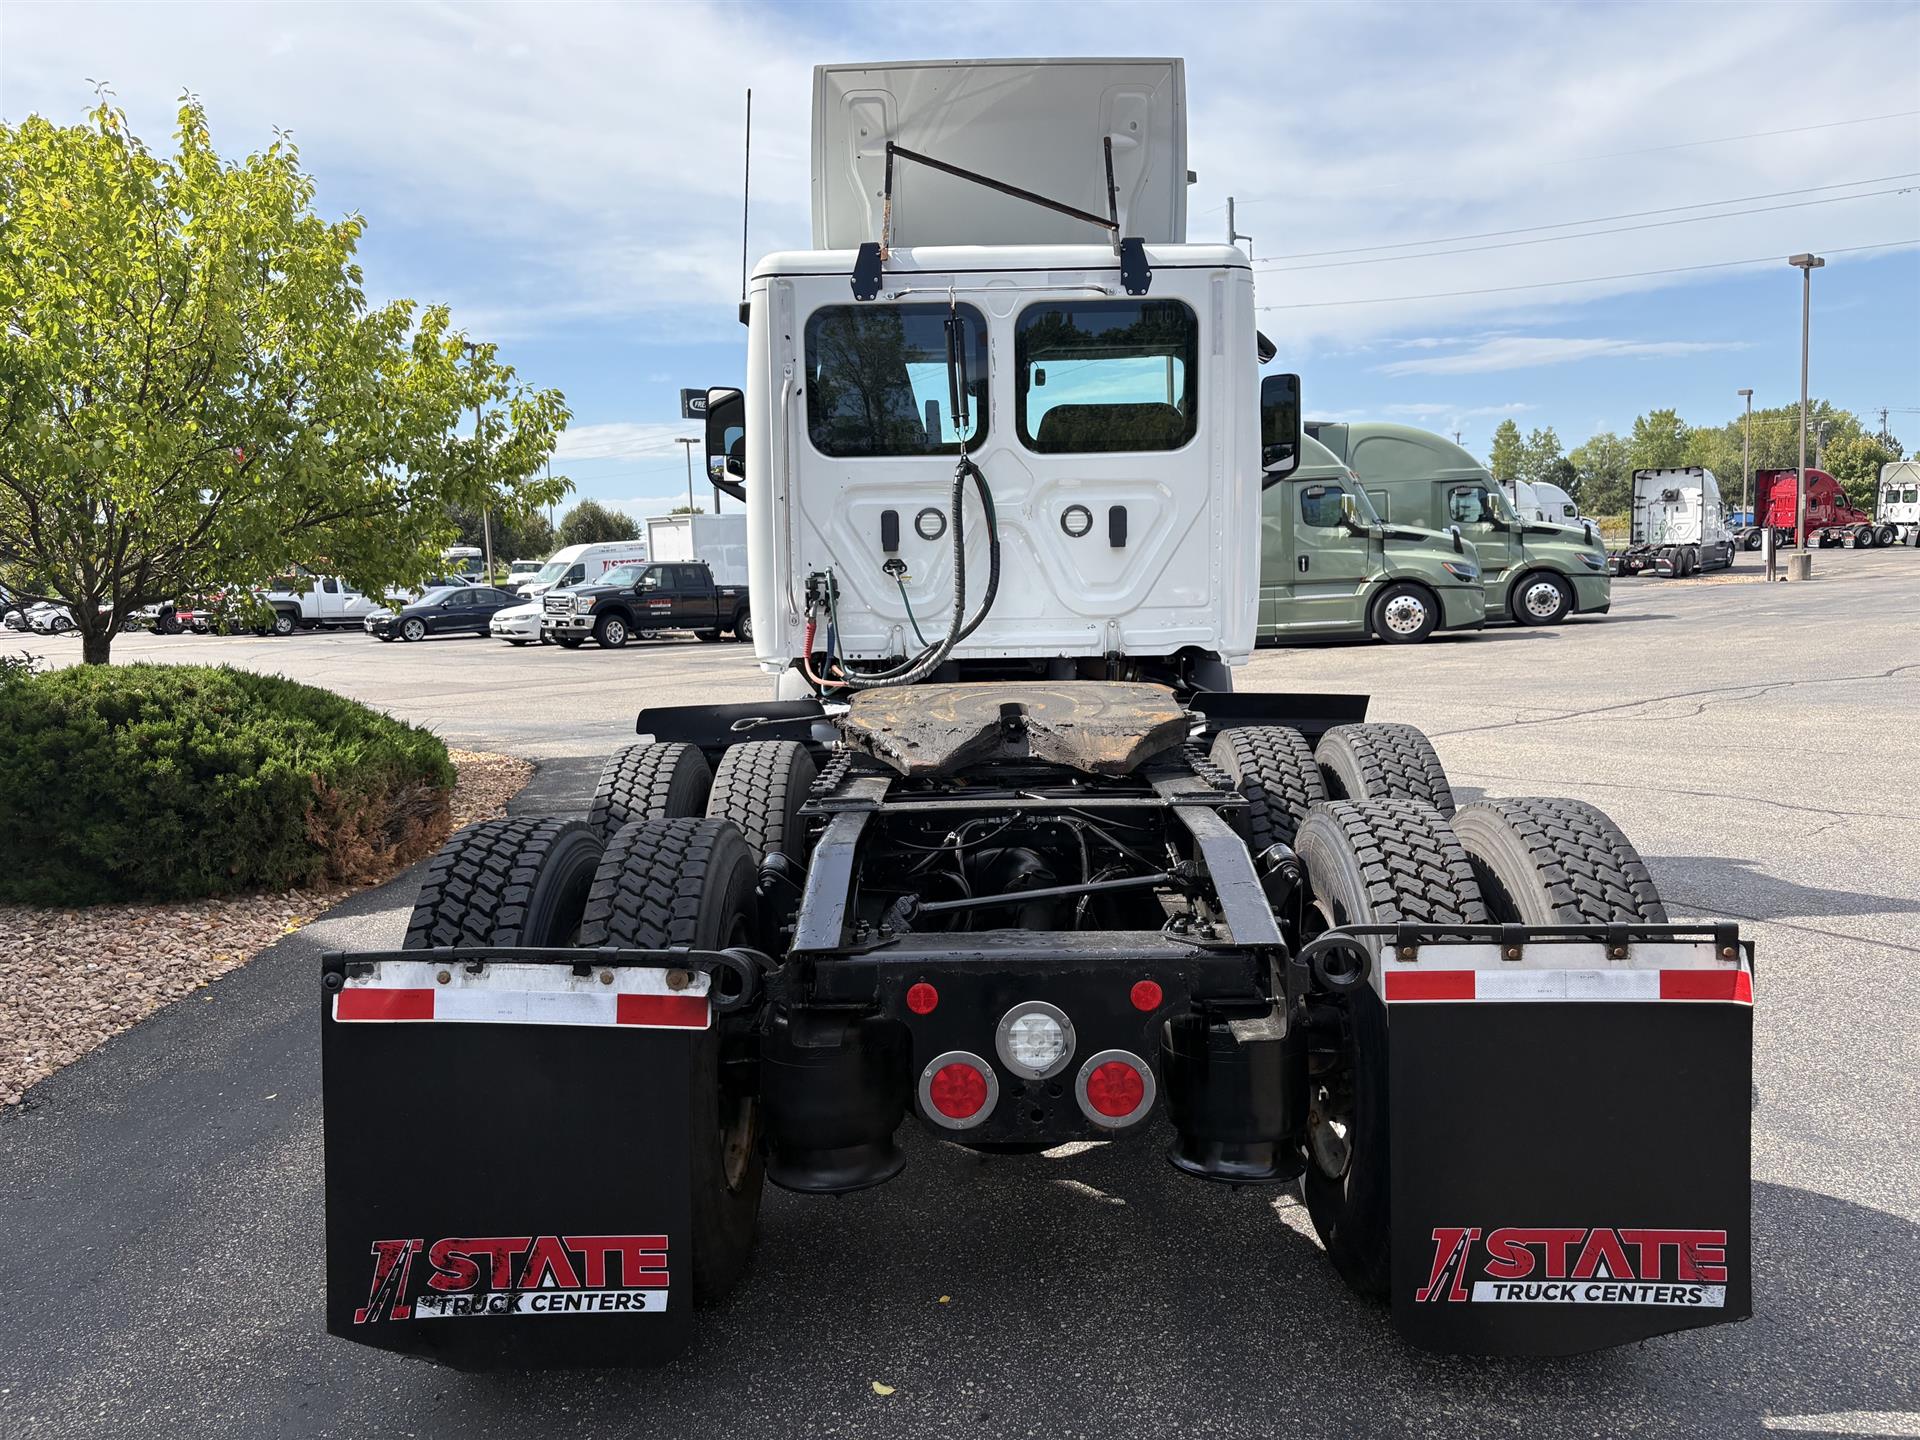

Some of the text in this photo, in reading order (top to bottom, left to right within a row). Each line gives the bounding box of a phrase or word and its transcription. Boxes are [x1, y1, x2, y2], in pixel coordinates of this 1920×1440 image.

[694, 400, 706, 409] FRE
[427, 1235, 669, 1290] STATE
[1484, 1228, 1728, 1282] STATE
[437, 1293, 647, 1315] TRUCK CENTERS
[1492, 1283, 1703, 1304] TRUCK CENTERS
